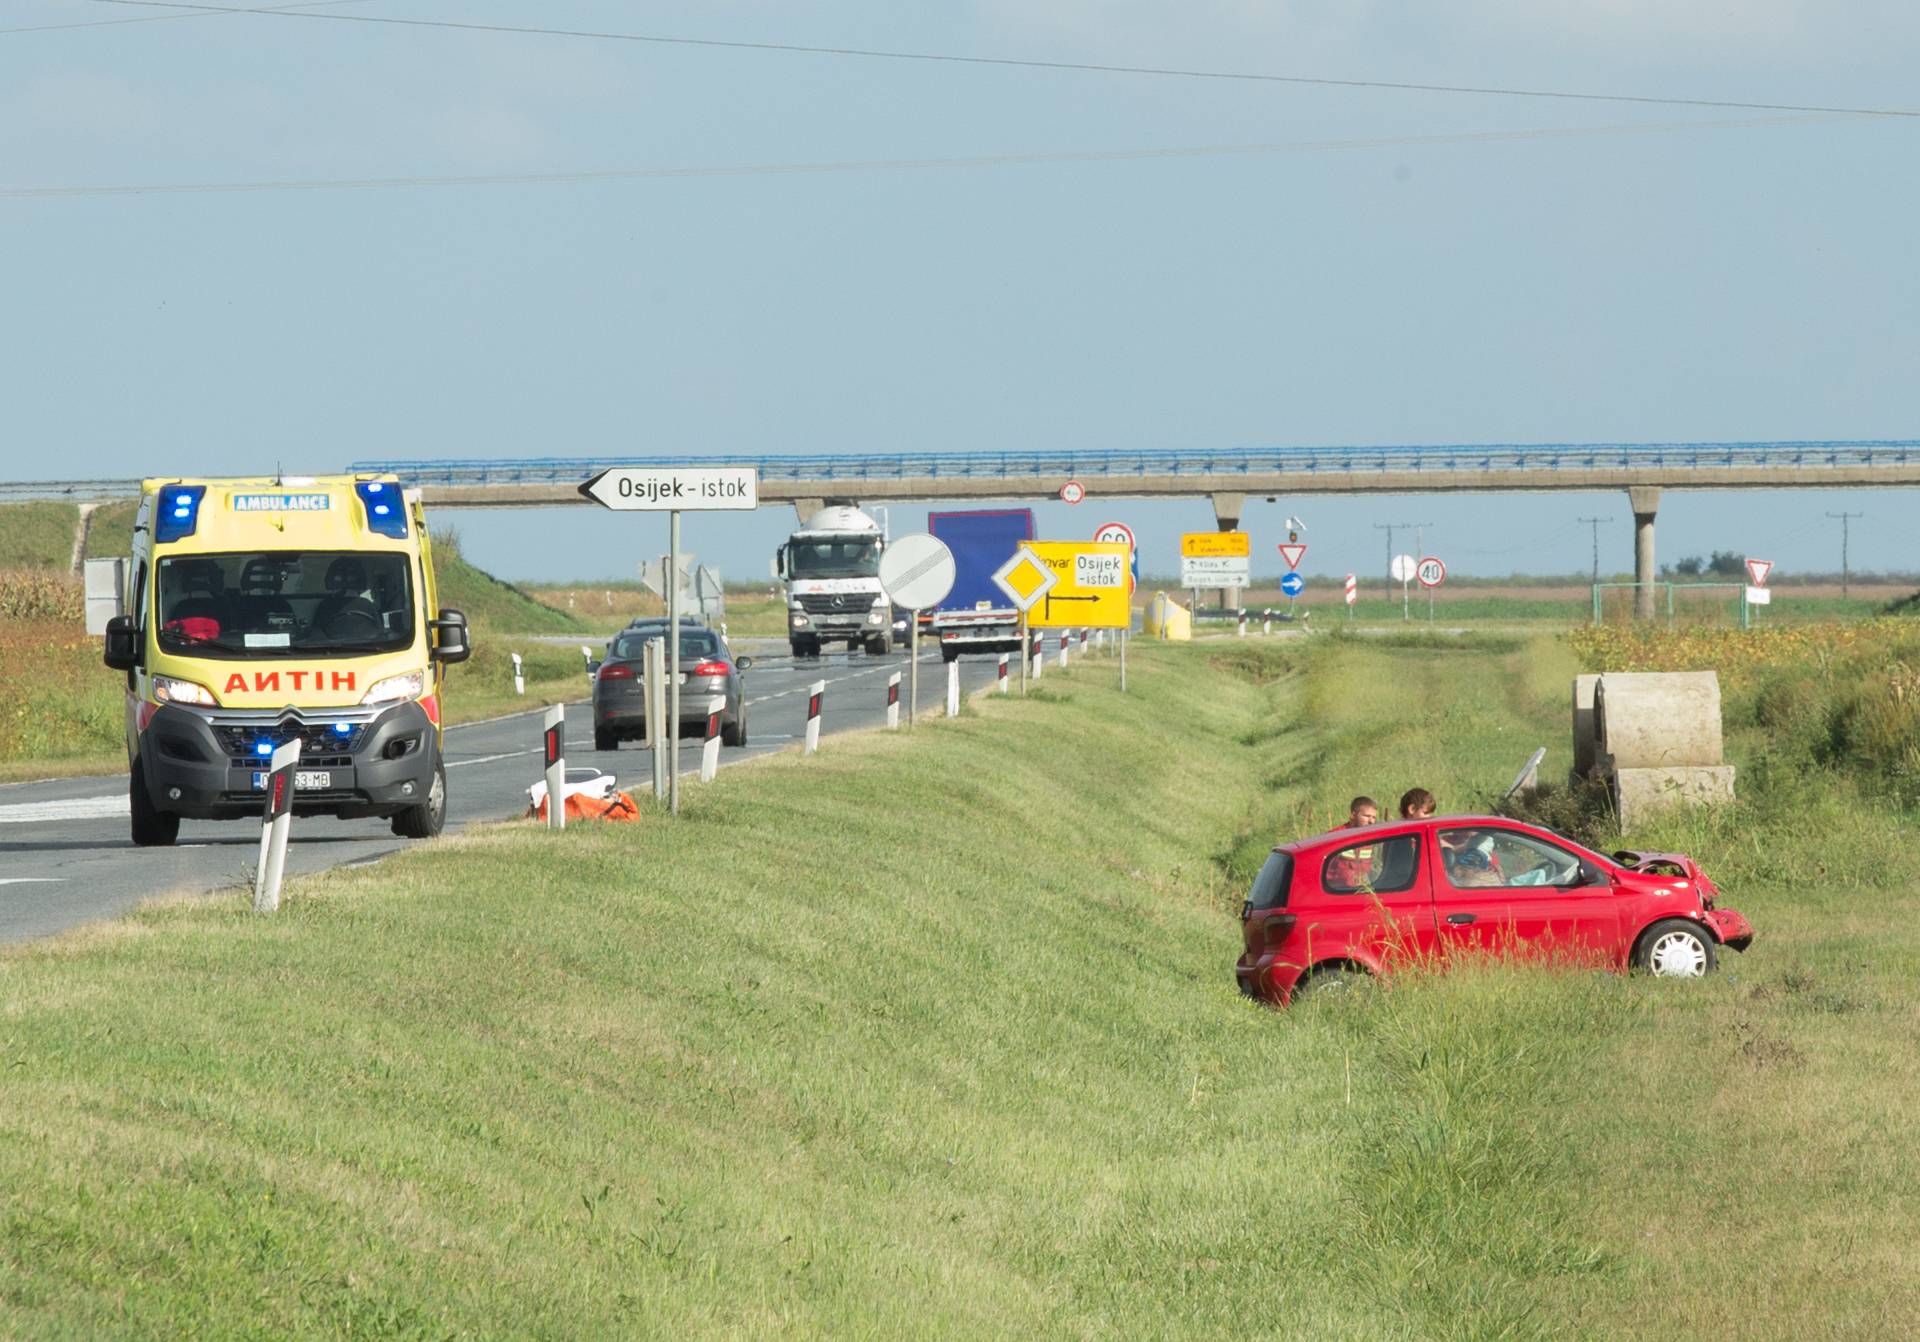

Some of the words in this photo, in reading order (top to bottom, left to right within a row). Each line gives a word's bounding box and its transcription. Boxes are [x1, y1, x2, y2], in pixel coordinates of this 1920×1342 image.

[236, 495, 325, 511] AMBULANCE
[1077, 556, 1120, 572] Osijek
[1421, 564, 1440, 580] 40
